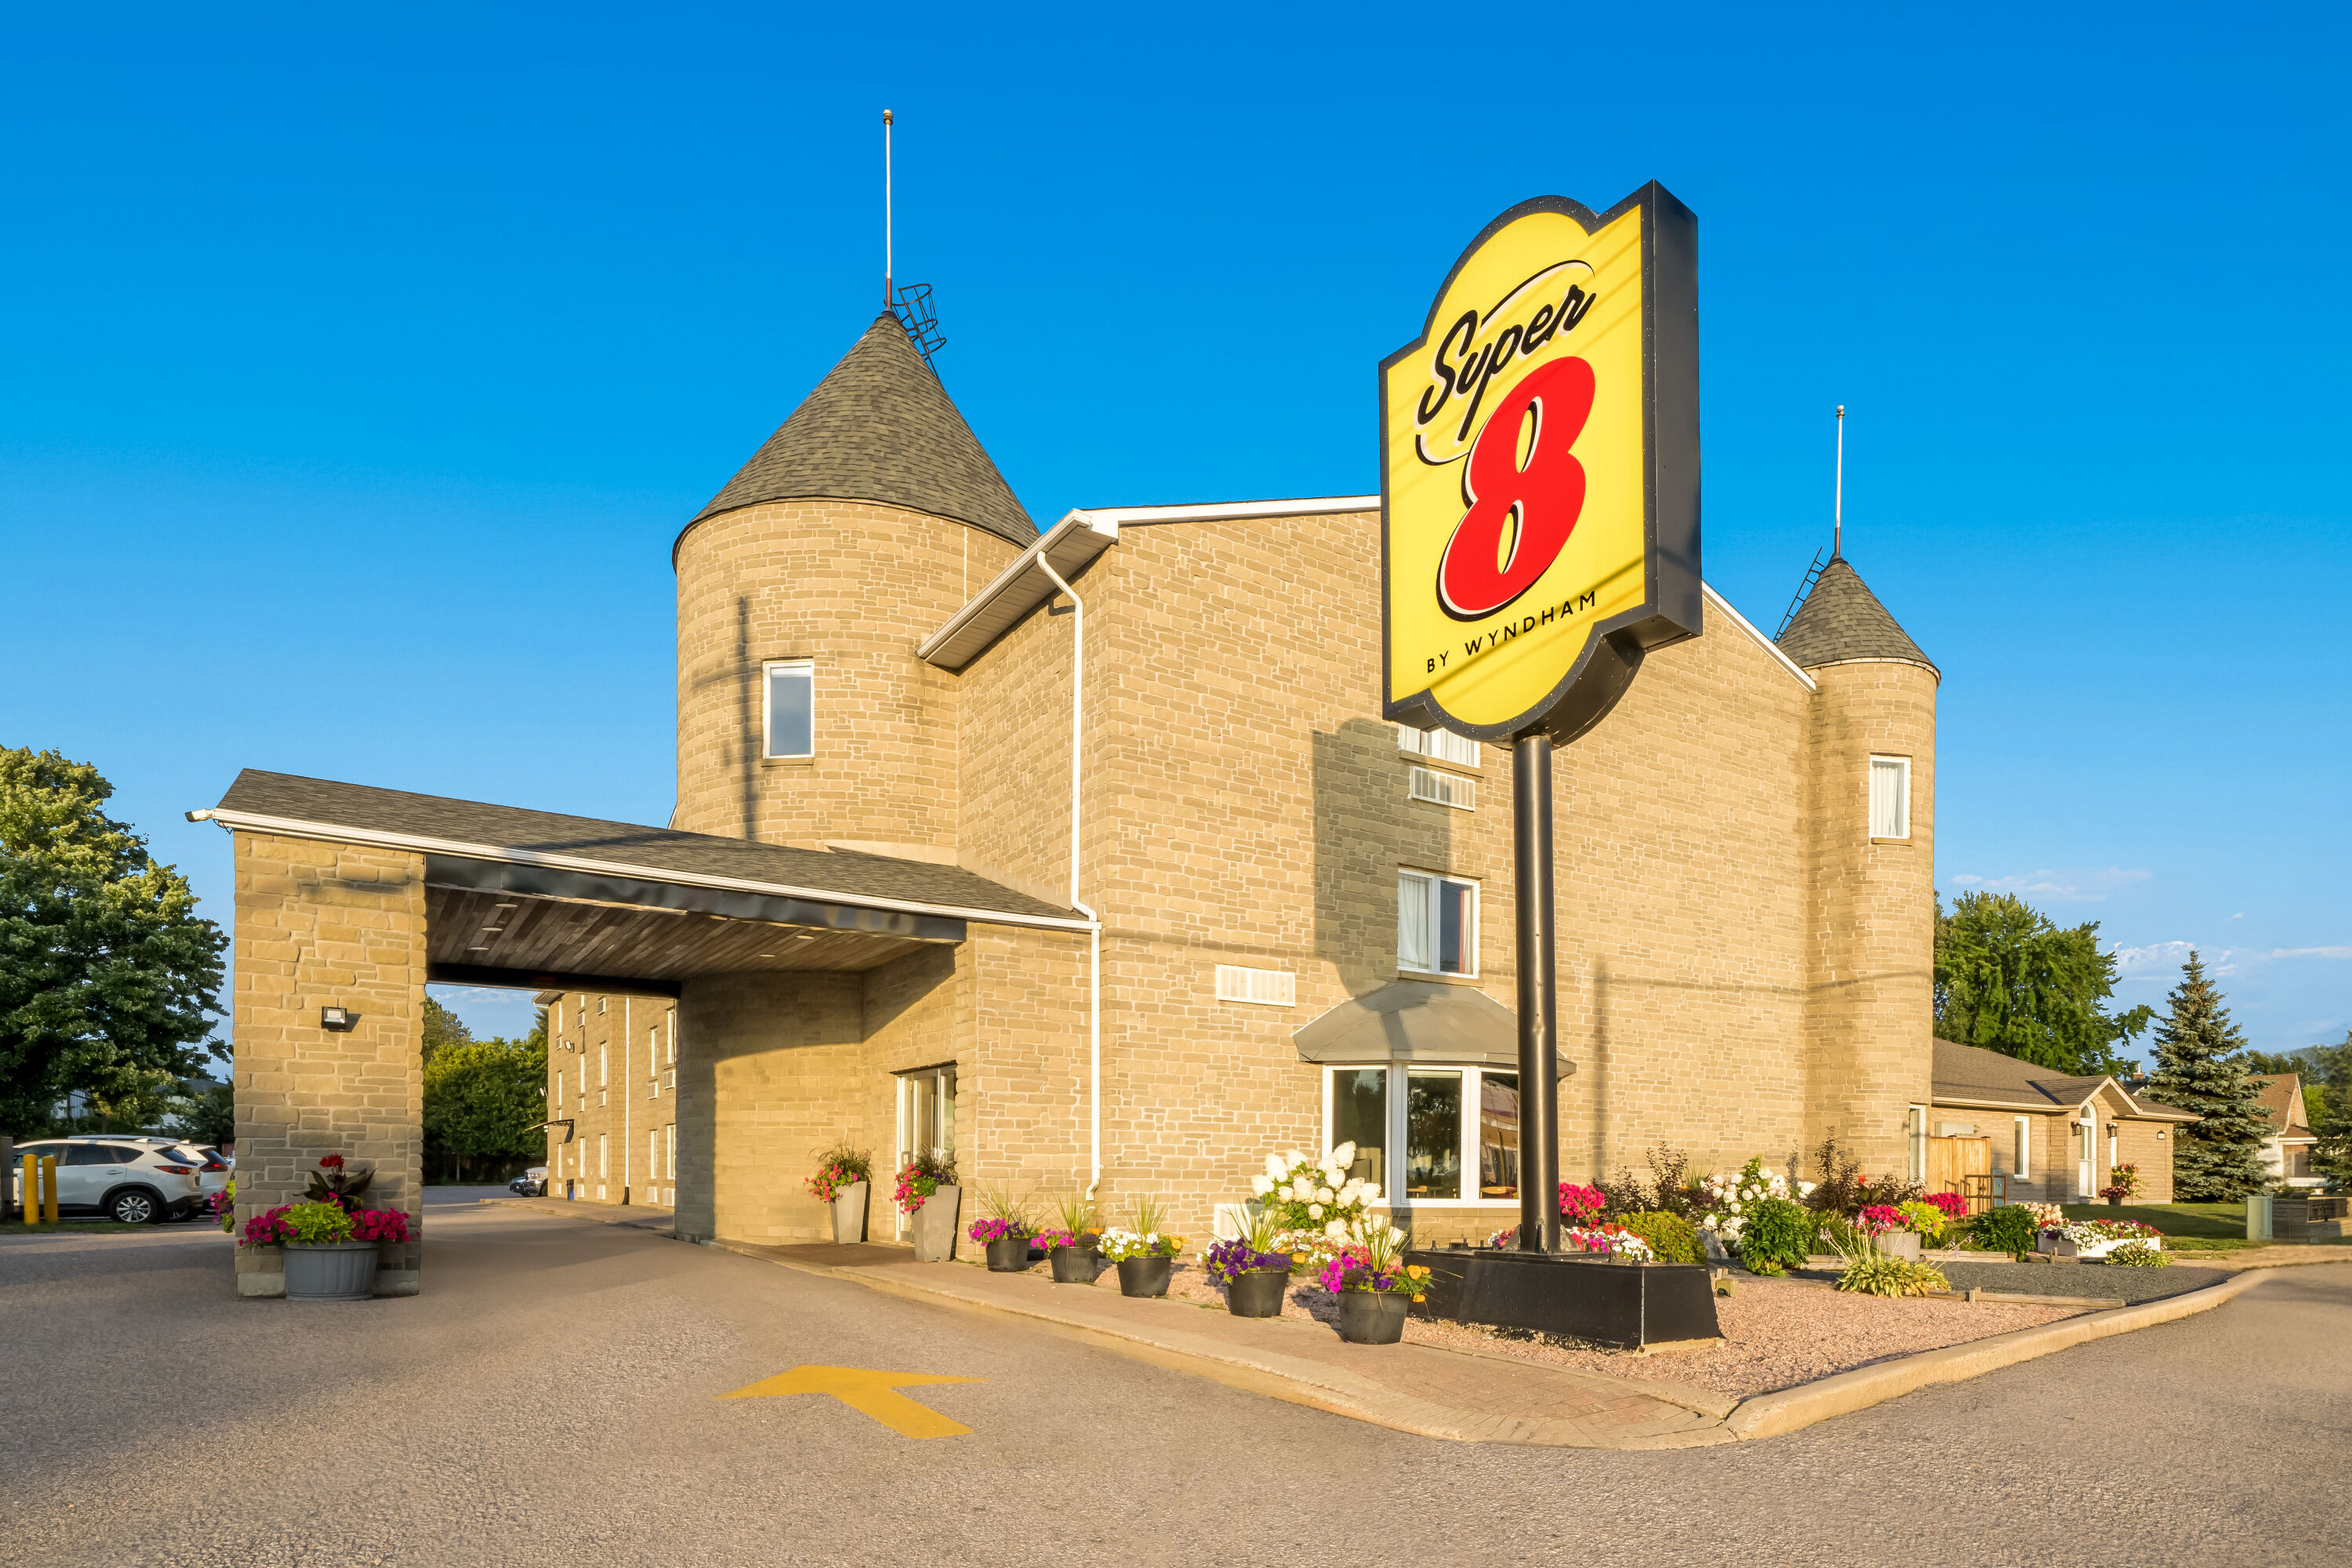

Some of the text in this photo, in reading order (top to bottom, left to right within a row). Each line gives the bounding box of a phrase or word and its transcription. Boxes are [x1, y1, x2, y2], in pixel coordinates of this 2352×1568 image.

[1417, 284, 1597, 441] Super
[1436, 357, 1595, 622] 8
[1427, 590, 1596, 673] BY WYNDHAM
